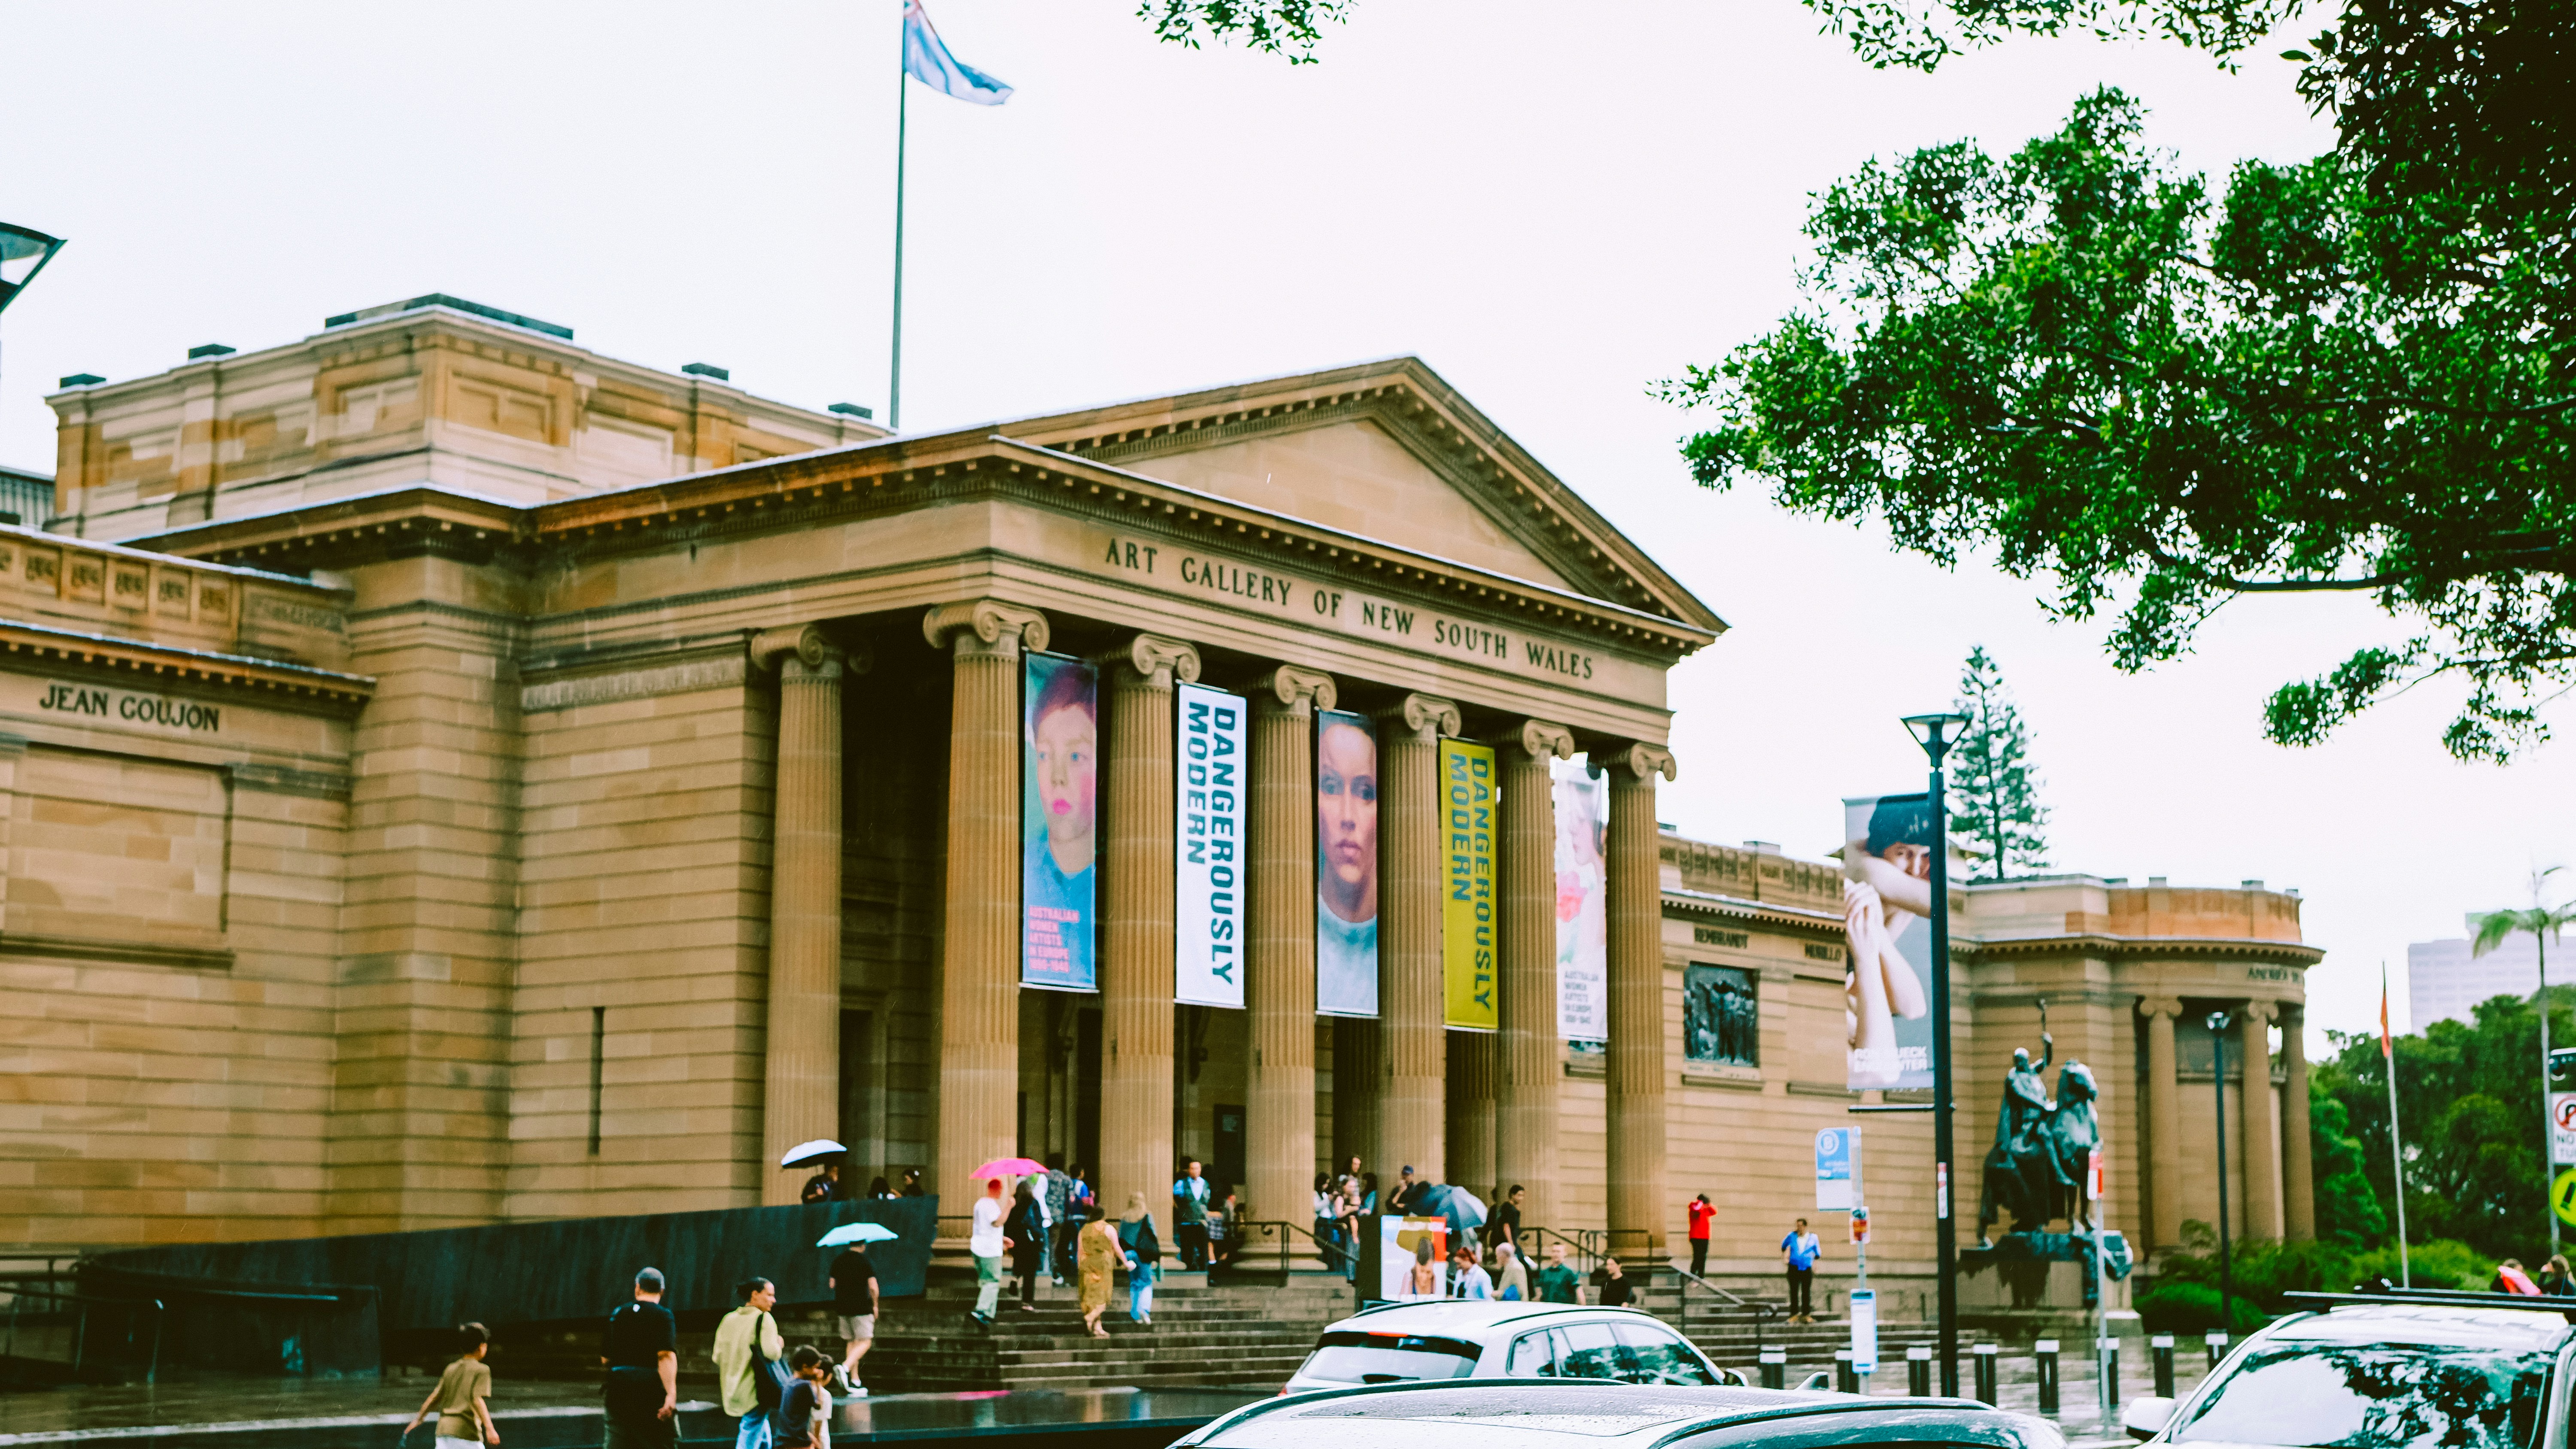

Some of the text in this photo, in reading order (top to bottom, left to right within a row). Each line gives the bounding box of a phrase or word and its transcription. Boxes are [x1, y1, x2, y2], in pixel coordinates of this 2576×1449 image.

[1106, 538, 1593, 680] ART GALLERY OF NEW SOUTH WALES
[40, 684, 109, 716] JEAN
[1188, 702, 1209, 864] MODERN
[1211, 707, 1236, 985] DANGEROUSLY
[1450, 752, 1471, 901] MODERN
[1471, 758, 1491, 1010] DANGEROUSLY
[2557, 1134, 2575, 1145] NO
